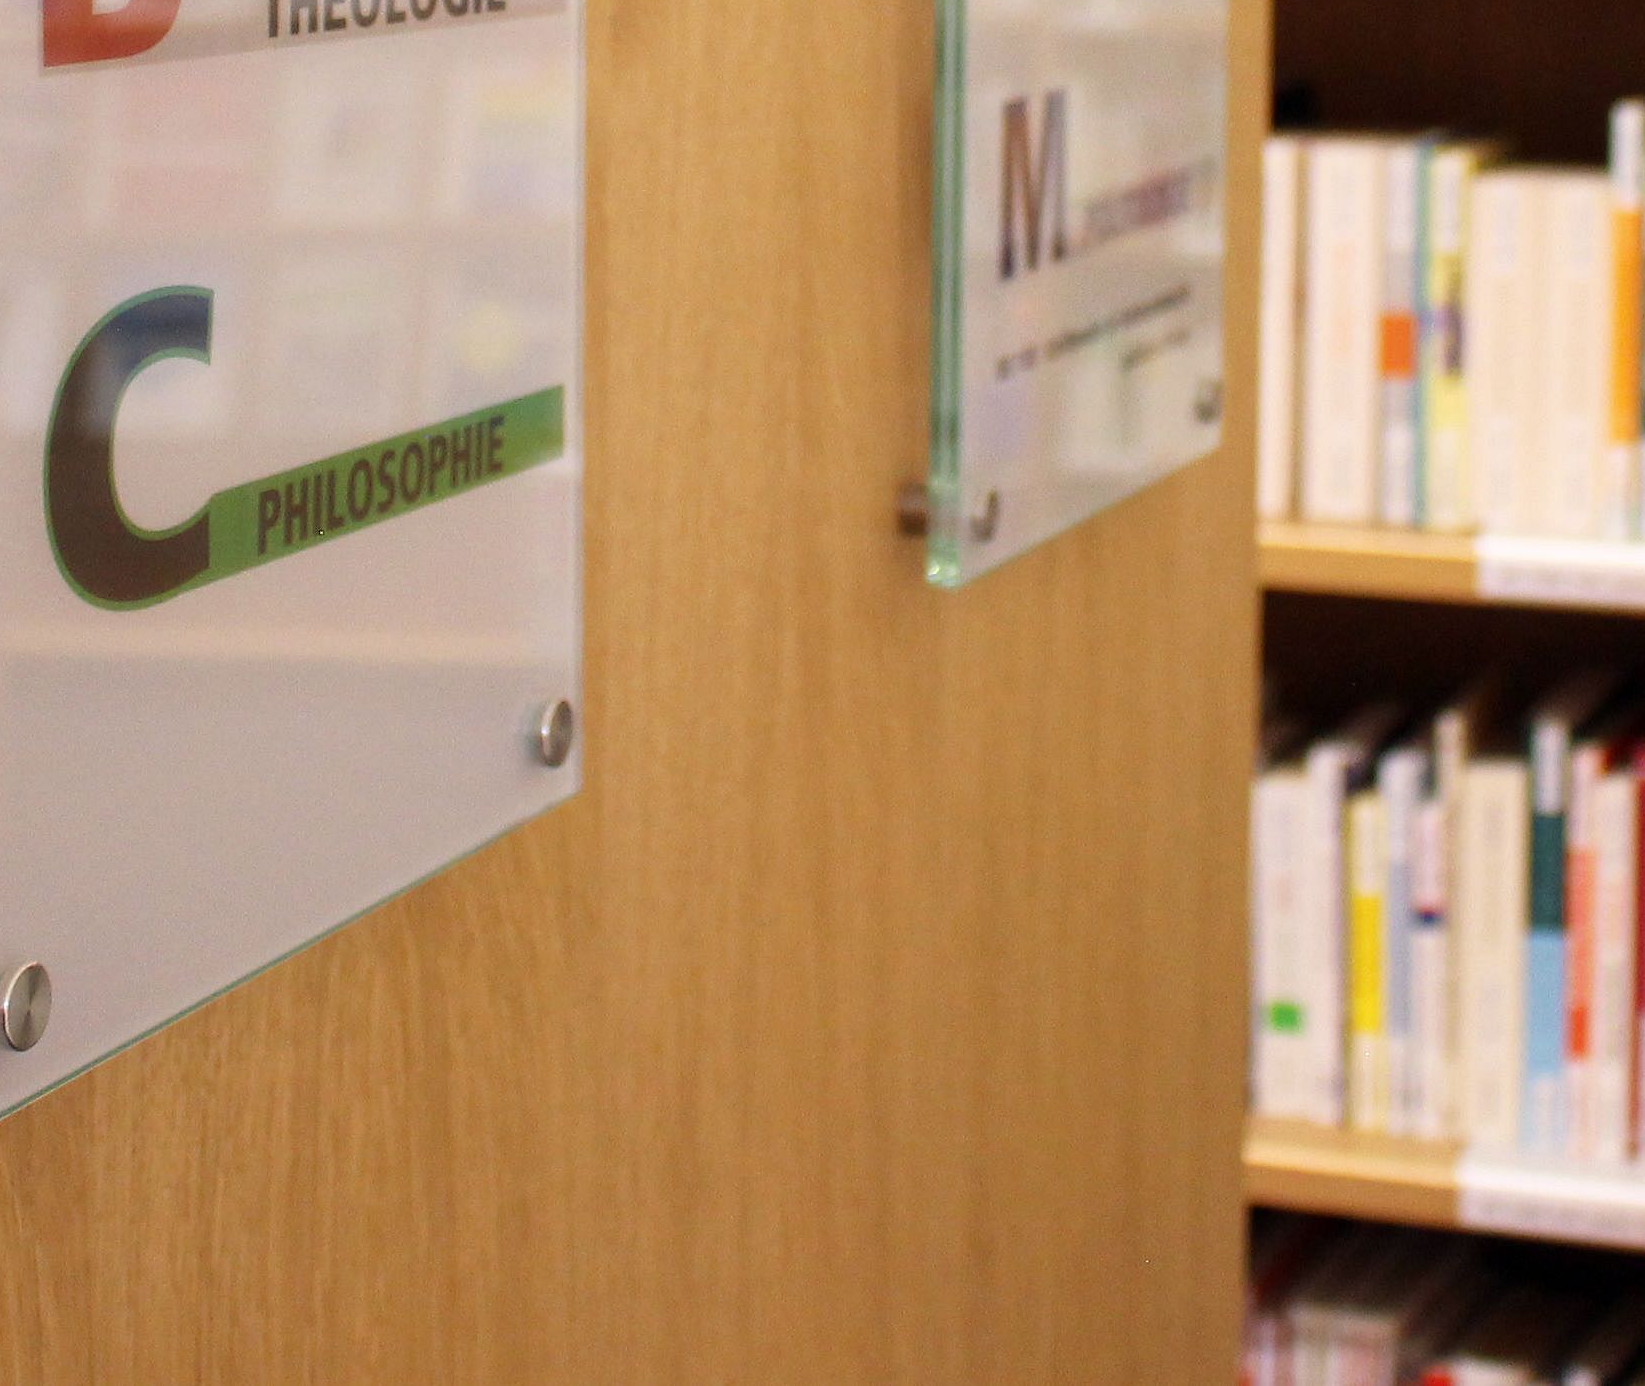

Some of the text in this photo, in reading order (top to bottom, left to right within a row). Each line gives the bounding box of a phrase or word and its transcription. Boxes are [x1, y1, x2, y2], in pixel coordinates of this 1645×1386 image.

[999, 87, 1069, 280] M
[44, 284, 214, 612] C
[256, 414, 506, 556] PHILOSOPHIE
